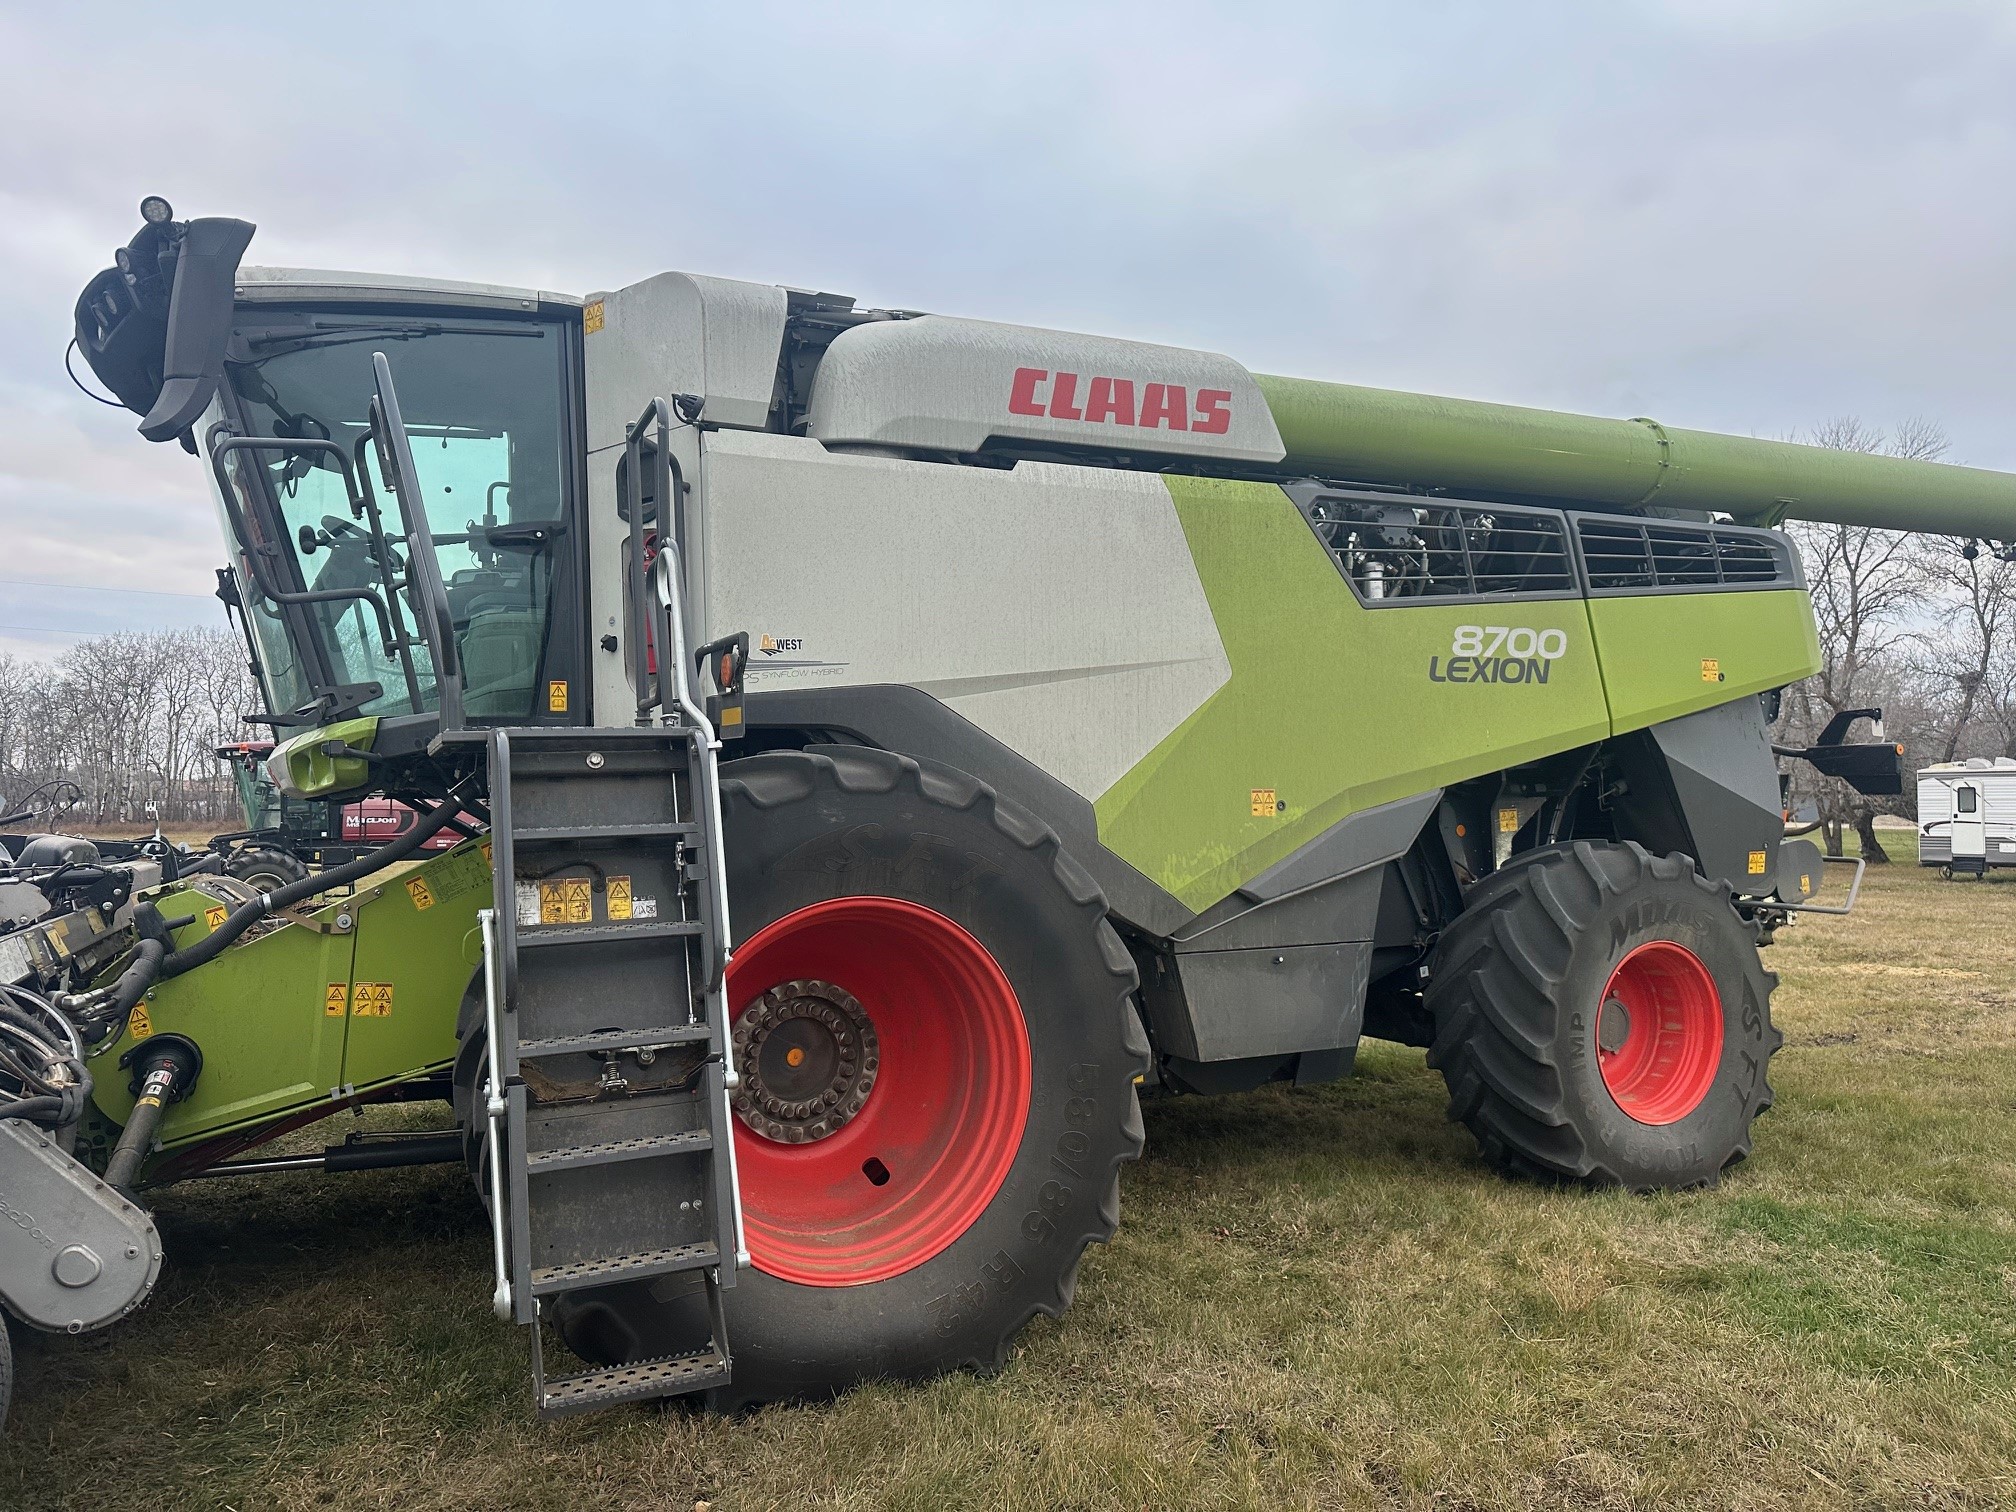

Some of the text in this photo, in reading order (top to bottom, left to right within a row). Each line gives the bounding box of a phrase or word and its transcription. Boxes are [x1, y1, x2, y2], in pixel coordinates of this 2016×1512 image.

[1008, 366, 1233, 435] CLAAS
[1428, 655, 1551, 684] LEXION
[1452, 624, 1568, 659] 8700
[761, 669, 810, 680] SYNFLOW
[811, 667, 844, 677] HYBRID
[824, 822, 1006, 892] SFT
[1732, 1003, 1763, 1119] SFT
[0, 1192, 56, 1251] acDon
